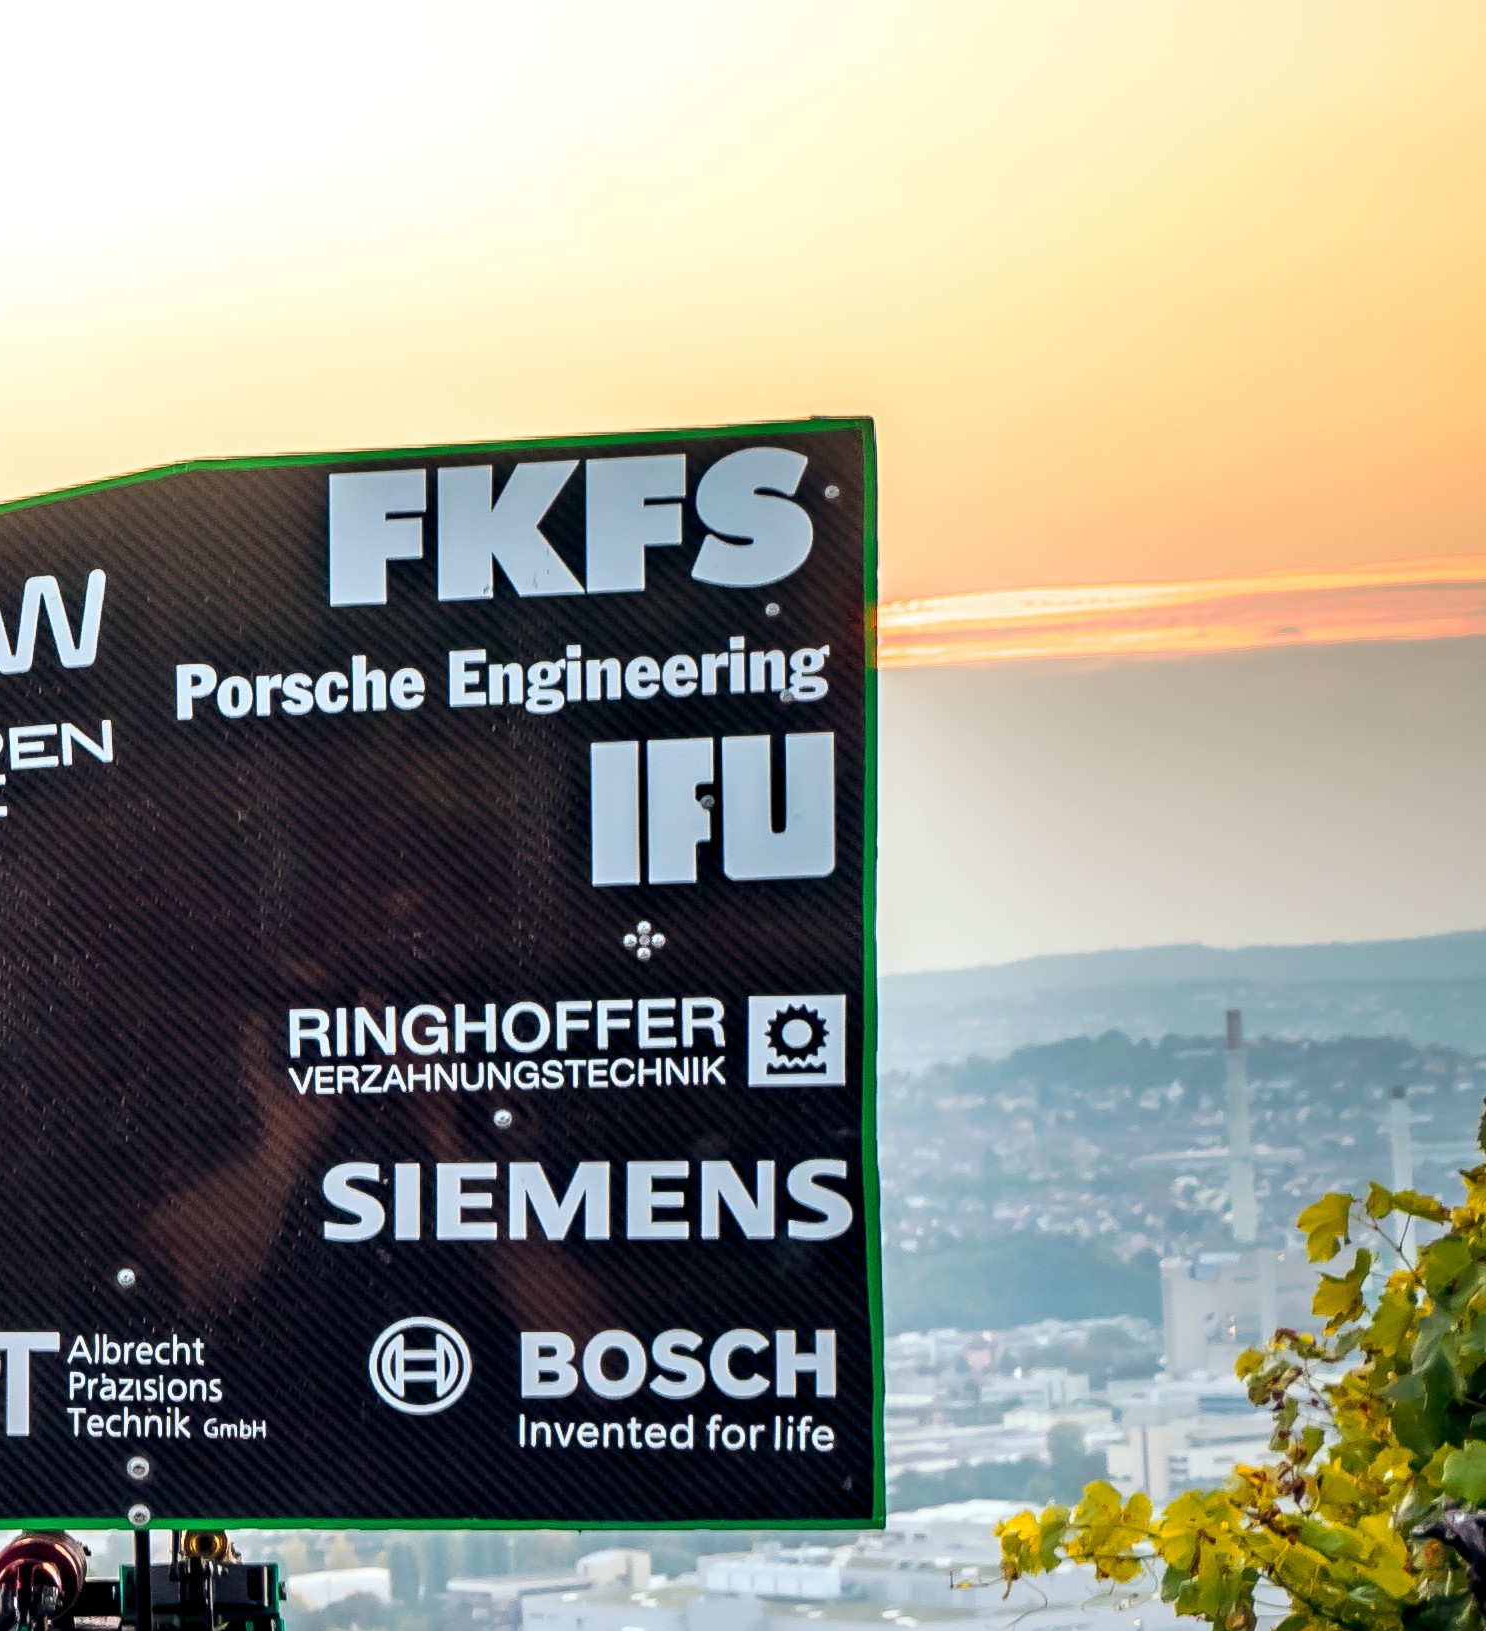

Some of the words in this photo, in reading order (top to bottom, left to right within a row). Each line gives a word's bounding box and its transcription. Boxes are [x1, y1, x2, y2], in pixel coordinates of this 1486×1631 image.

[329, 447, 814, 608] FKFS
[175, 655, 425, 721] Porsche
[449, 636, 830, 714] Engineering
[591, 732, 835, 886] IFU
[289, 998, 726, 1058] RINGHOFFER
[289, 1055, 726, 1095] VERZAHNUNGSTECHNIK
[321, 1159, 853, 1241] SIEMENS
[67, 1333, 205, 1366] Albrecht
[520, 1329, 837, 1399] BOSCH
[67, 1406, 191, 1439] Technik
[203, 1417, 267, 1440] GmbH
[518, 1414, 695, 1451] Invented
[706, 1414, 765, 1450] for
[772, 1414, 835, 1451] life
